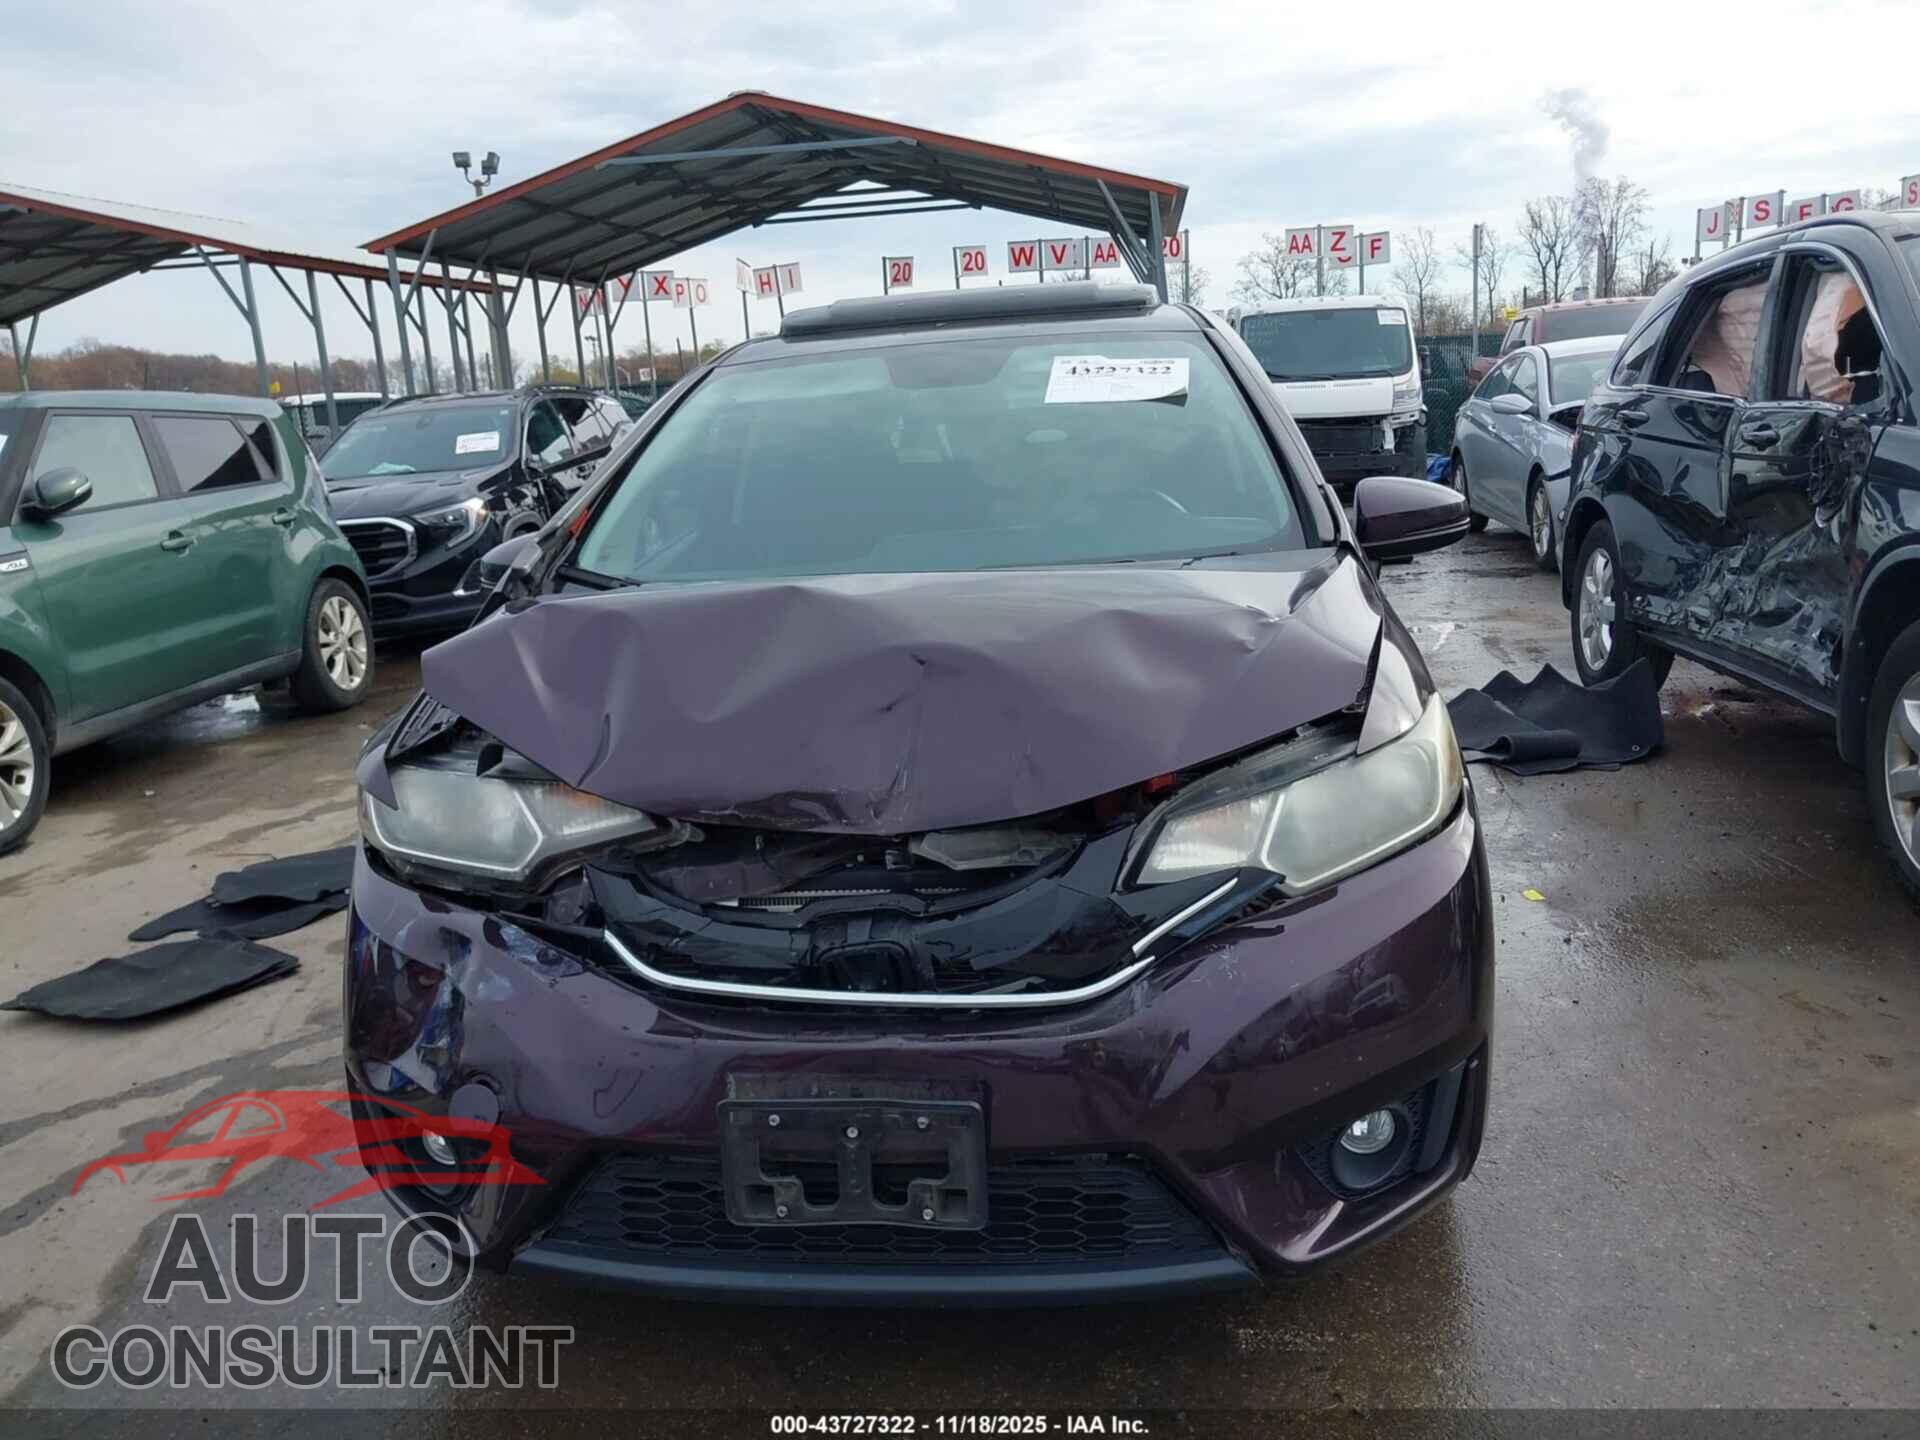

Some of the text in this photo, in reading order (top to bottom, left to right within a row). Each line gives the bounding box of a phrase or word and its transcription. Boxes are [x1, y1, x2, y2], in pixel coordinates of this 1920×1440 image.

[1754, 200, 1770, 221] S
[1706, 212, 1718, 234] J
[1289, 233, 1313, 255] AA
[1330, 231, 1346, 252] Z
[1370, 238, 1383, 259] F
[962, 252, 985, 273] 20
[1010, 246, 1034, 267] W
[1050, 244, 1067, 265] V
[1094, 243, 1117, 263] AA
[758, 272, 773, 294] H
[891, 262, 912, 283] 20
[653, 276, 669, 296] X
[675, 283, 685, 304] P
